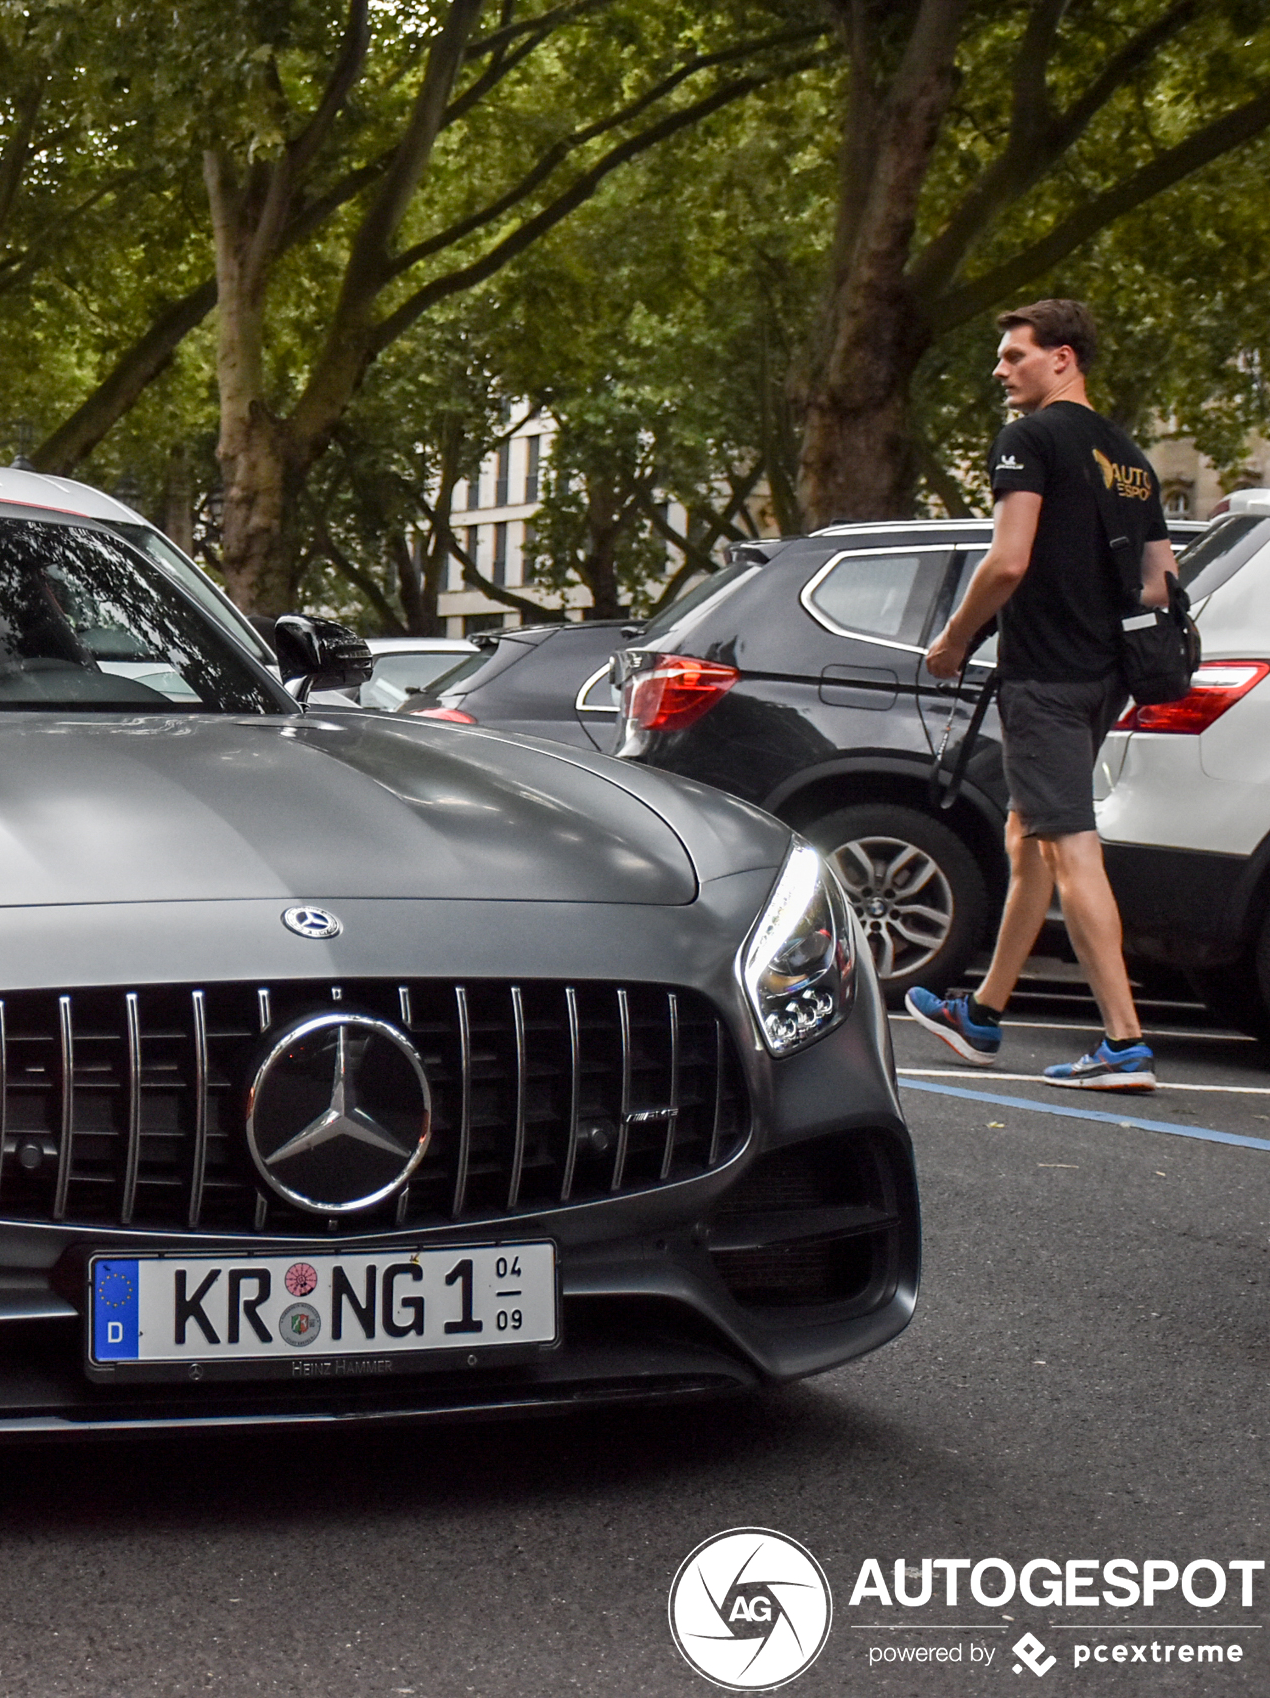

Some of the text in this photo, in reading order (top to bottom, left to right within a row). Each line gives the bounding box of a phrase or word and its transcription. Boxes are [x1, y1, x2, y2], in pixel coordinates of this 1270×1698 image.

[496, 1256, 522, 1278] 04
[175, 1259, 483, 1345] KR NG 1
[496, 1309, 523, 1331] 09
[108, 1322, 123, 1343] D
